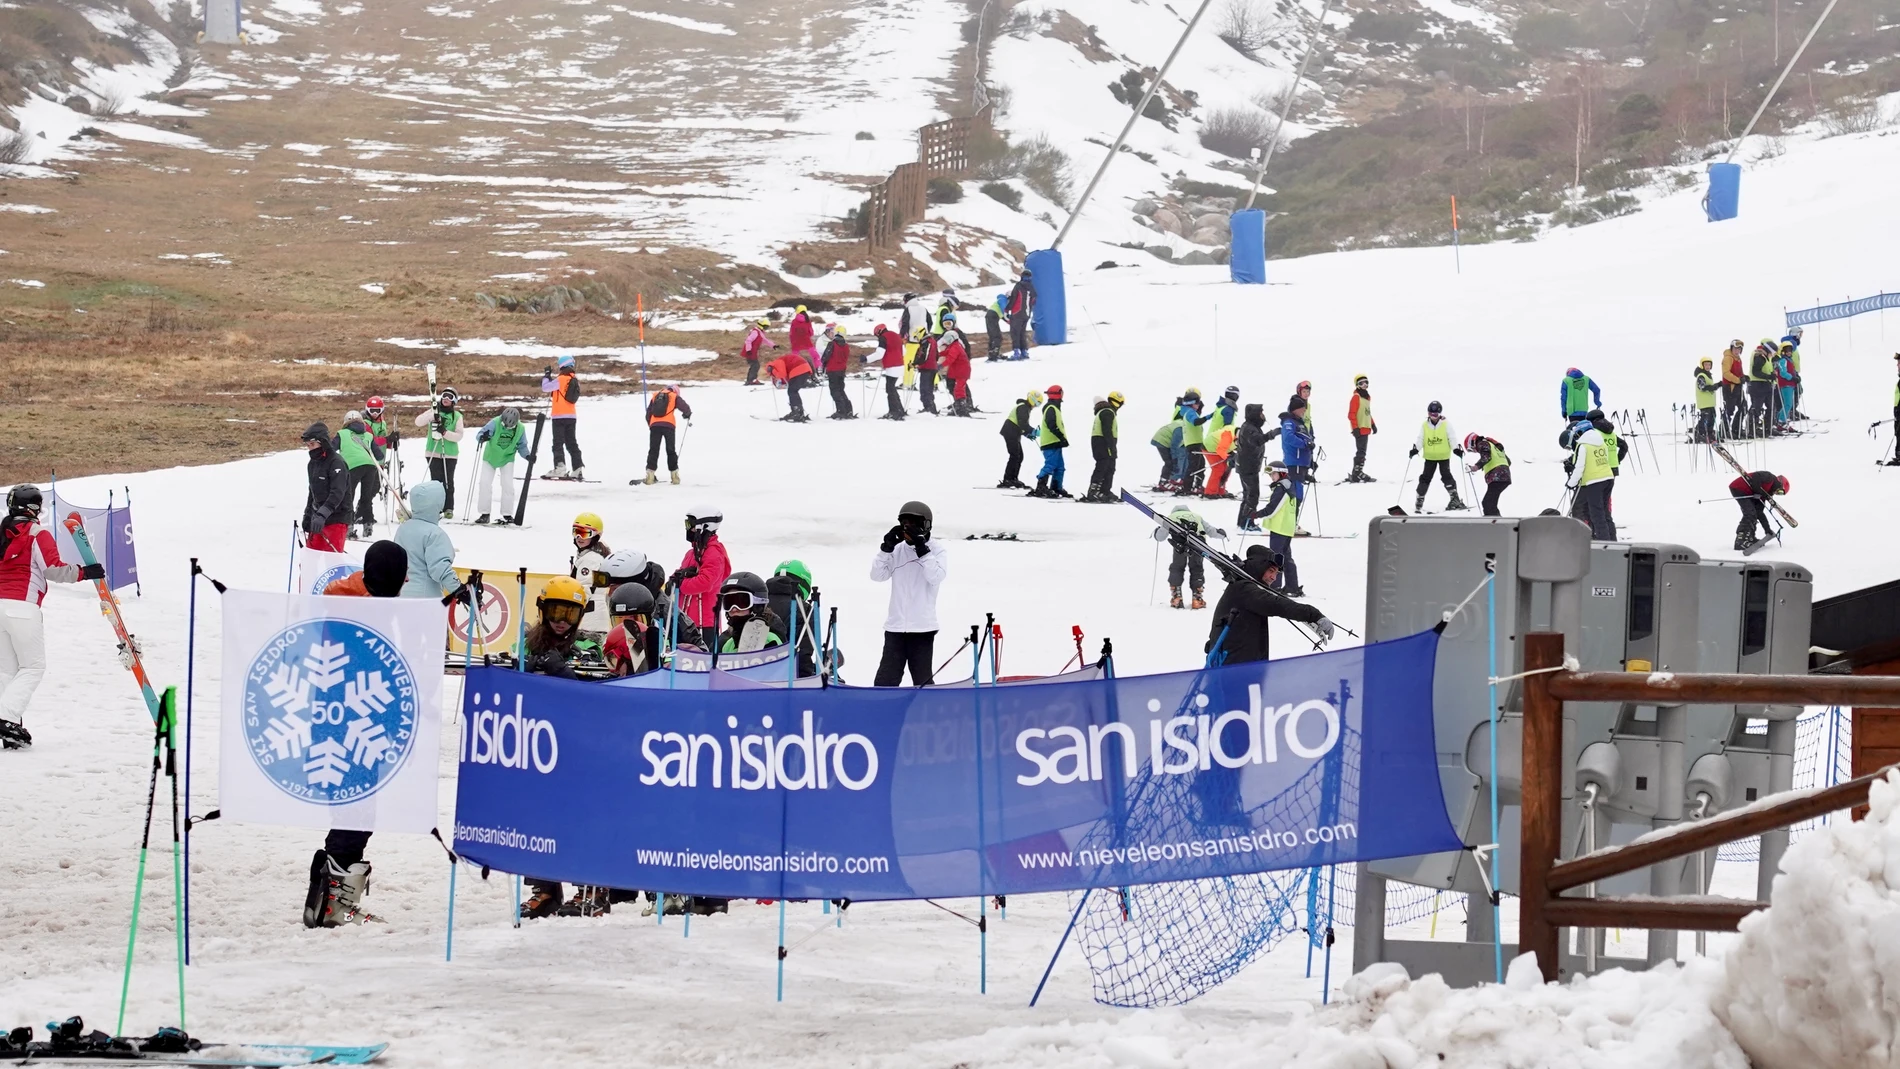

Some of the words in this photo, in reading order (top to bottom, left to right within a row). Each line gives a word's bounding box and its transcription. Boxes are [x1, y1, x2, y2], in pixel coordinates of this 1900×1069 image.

[250, 631, 298, 684] ISIDRO
[247, 692, 259, 727] SAN
[311, 701, 344, 725] 50
[364, 638, 413, 764] ANIVERSARIO
[252, 735, 274, 766] SKI
[471, 692, 558, 774] isidro
[639, 730, 723, 788] san
[727, 710, 879, 791] isidro
[1015, 722, 1138, 786] san
[1147, 683, 1340, 776] isidro
[288, 782, 314, 798] 1974
[333, 786, 363, 800] 2024
[637, 848, 889, 874] www.nieveleonsanisidro.com
[1018, 821, 1357, 869] www.nieveleonsanisidro.com
